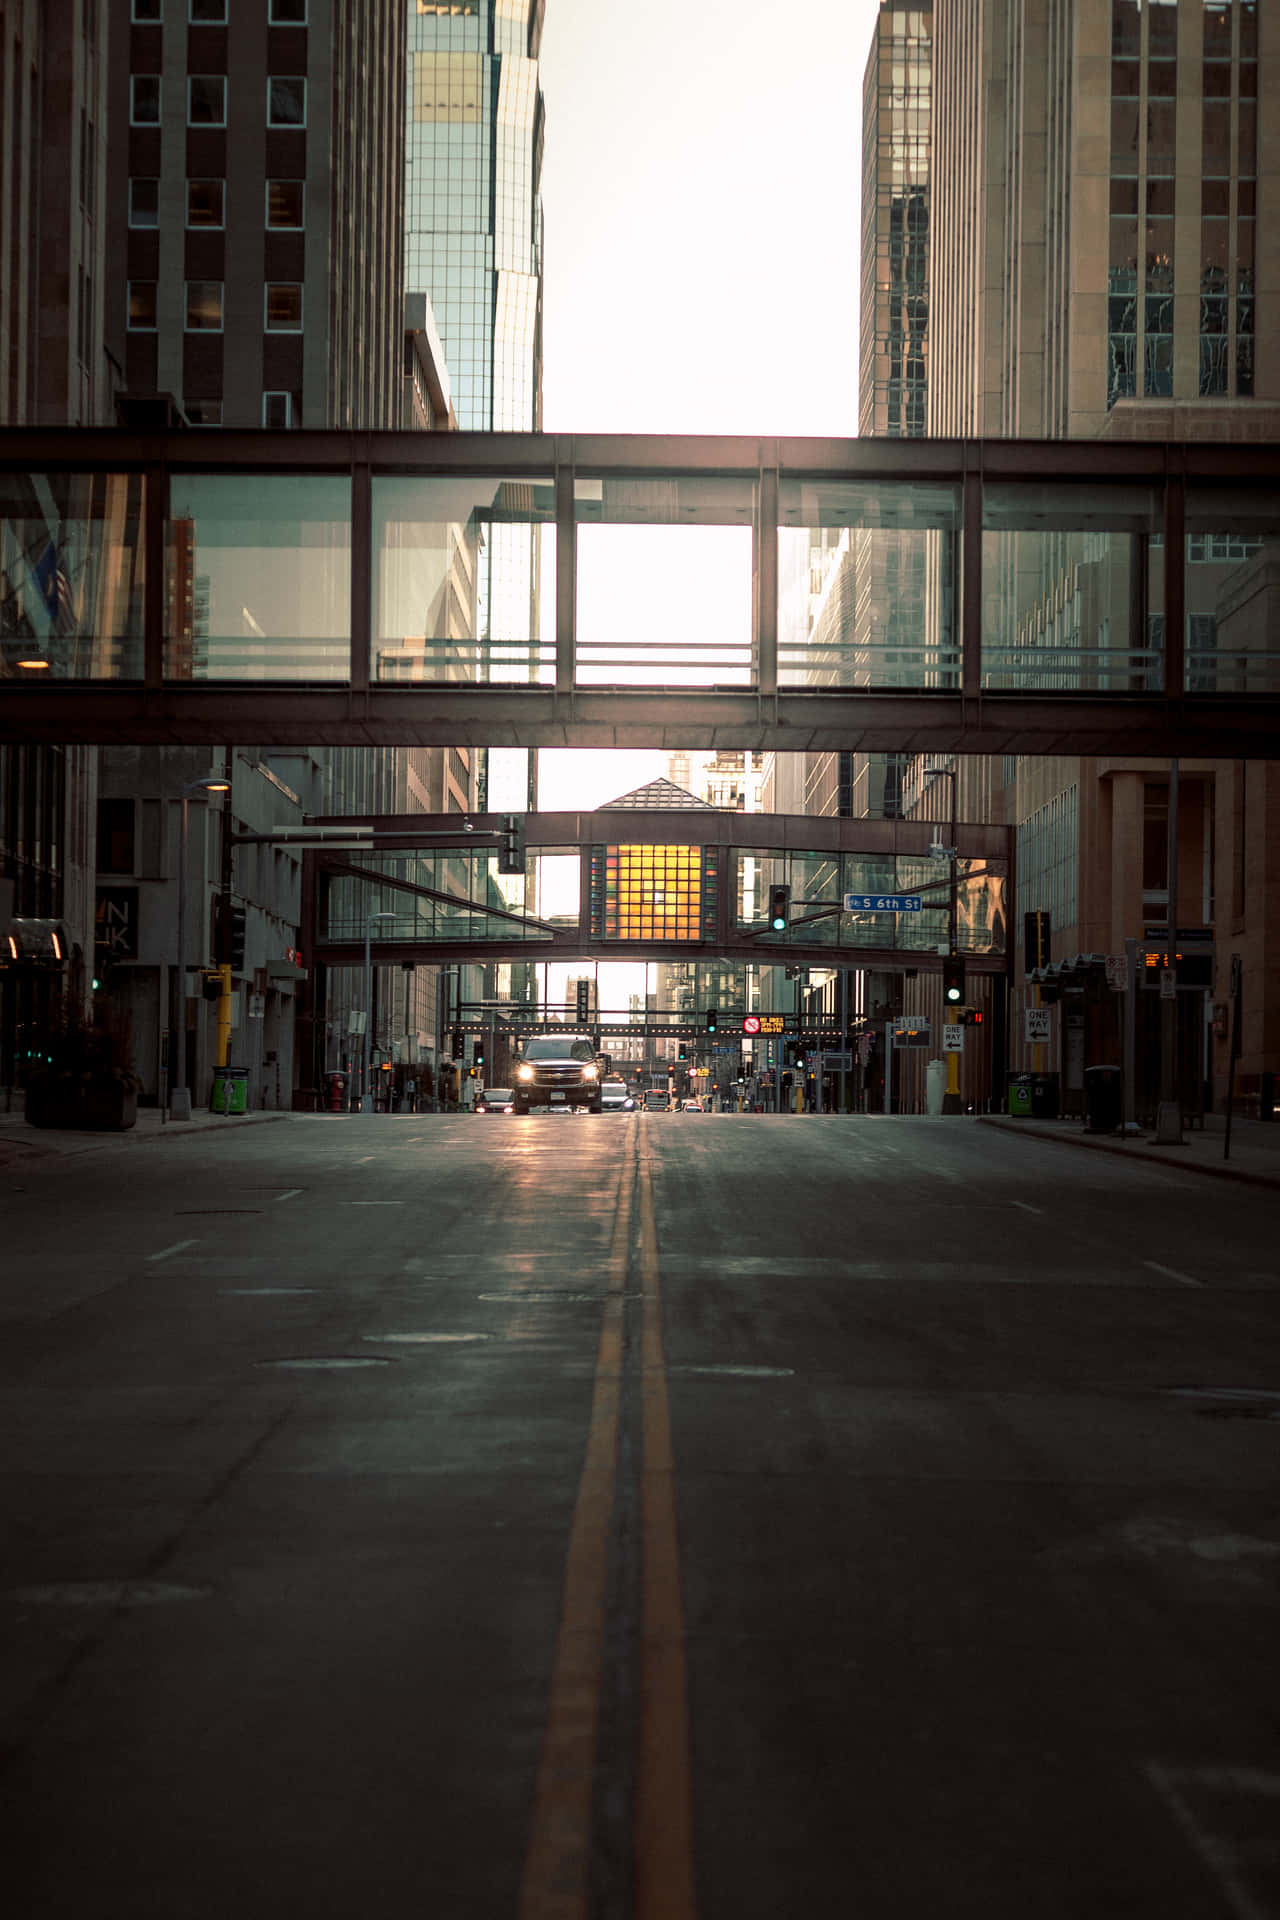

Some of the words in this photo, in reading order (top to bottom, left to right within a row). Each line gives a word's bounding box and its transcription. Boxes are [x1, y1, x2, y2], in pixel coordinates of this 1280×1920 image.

[863, 898, 871, 908] S
[877, 898, 899, 909] 6th
[904, 899, 919, 910] St
[1029, 1010, 1049, 1019] ONE
[1029, 1020, 1048, 1029] WAY
[945, 1033, 961, 1041] WAY
